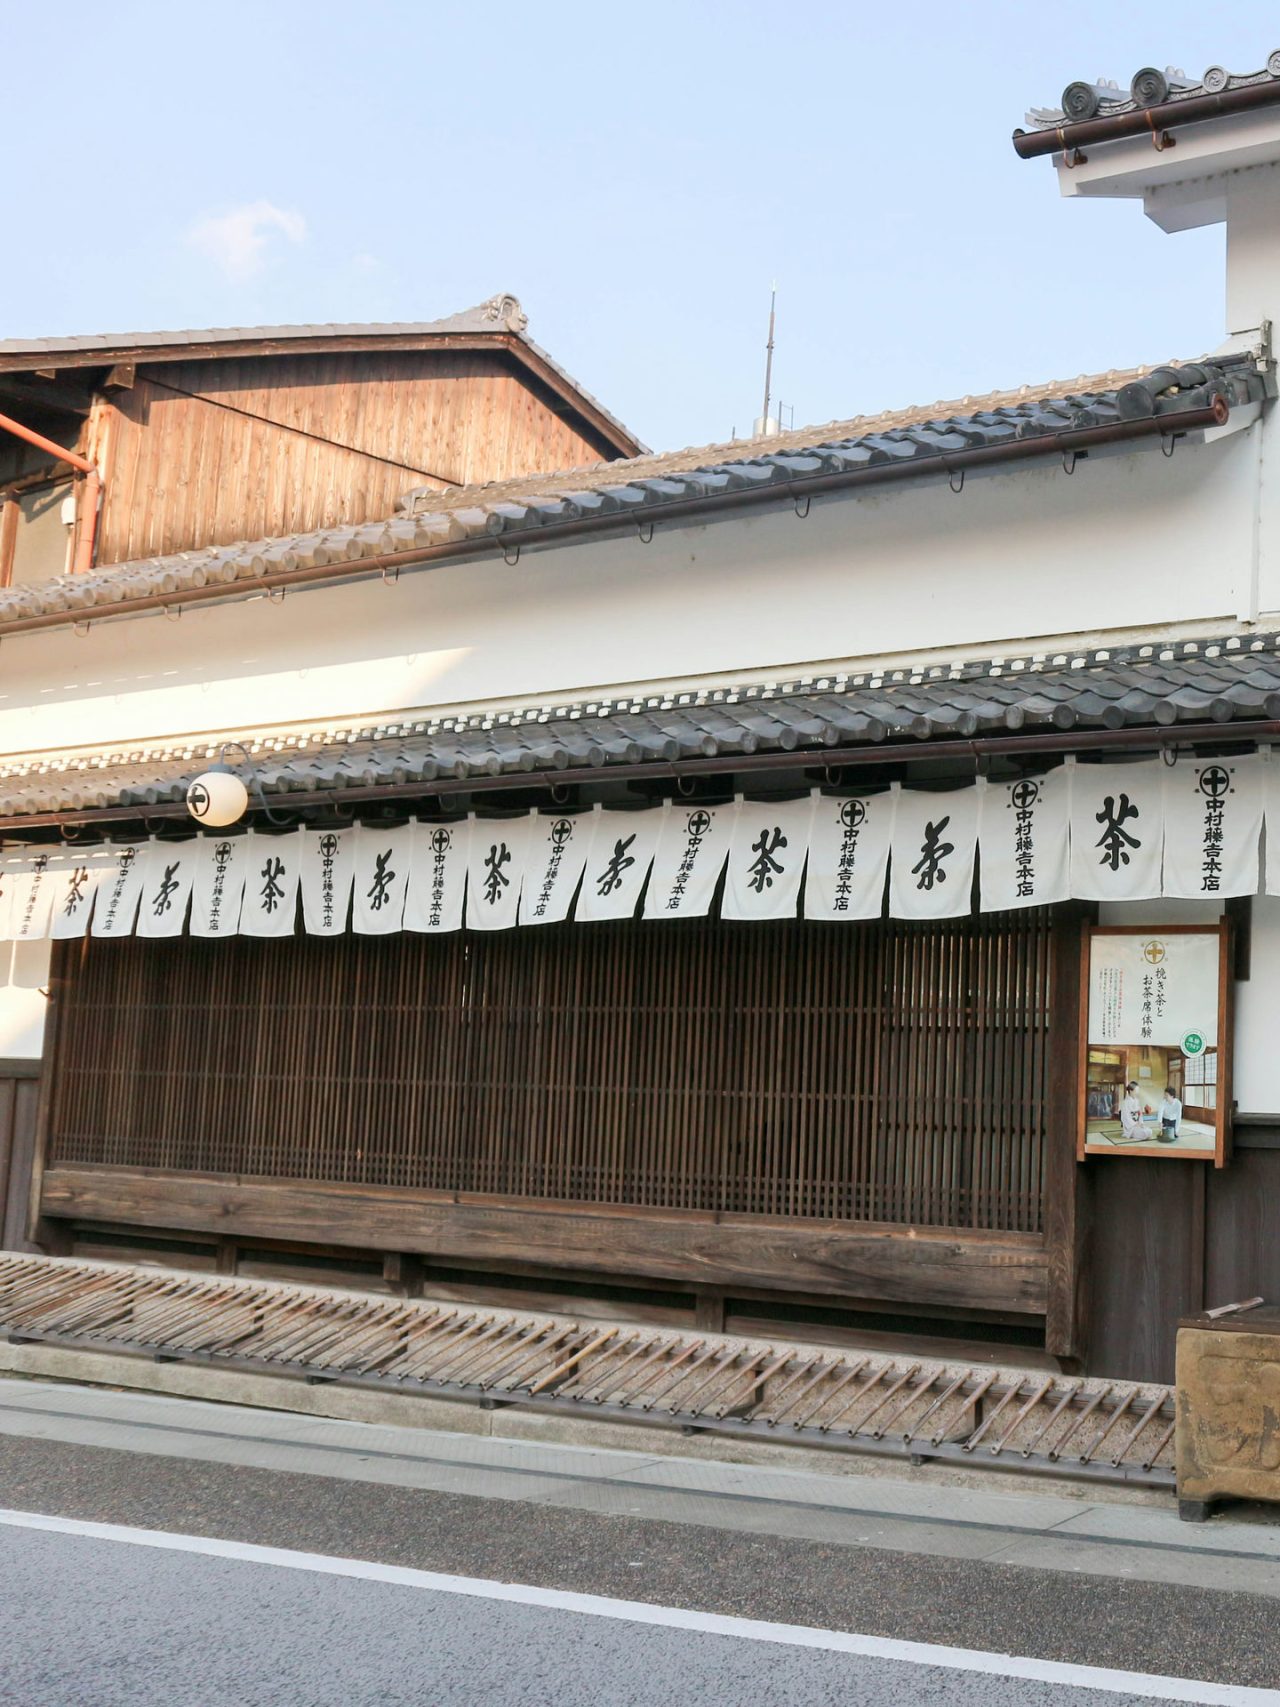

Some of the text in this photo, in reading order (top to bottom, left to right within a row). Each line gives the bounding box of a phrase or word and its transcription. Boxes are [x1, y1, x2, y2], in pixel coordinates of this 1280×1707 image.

[748, 827, 787, 893] 茶
[912, 816, 954, 890] 茶
[1096, 793, 1141, 871] 茶
[153, 861, 180, 915] 茶
[261, 857, 285, 913] 茶
[368, 849, 395, 910] 茶
[484, 843, 511, 904] 茶
[597, 834, 636, 895] 茶
